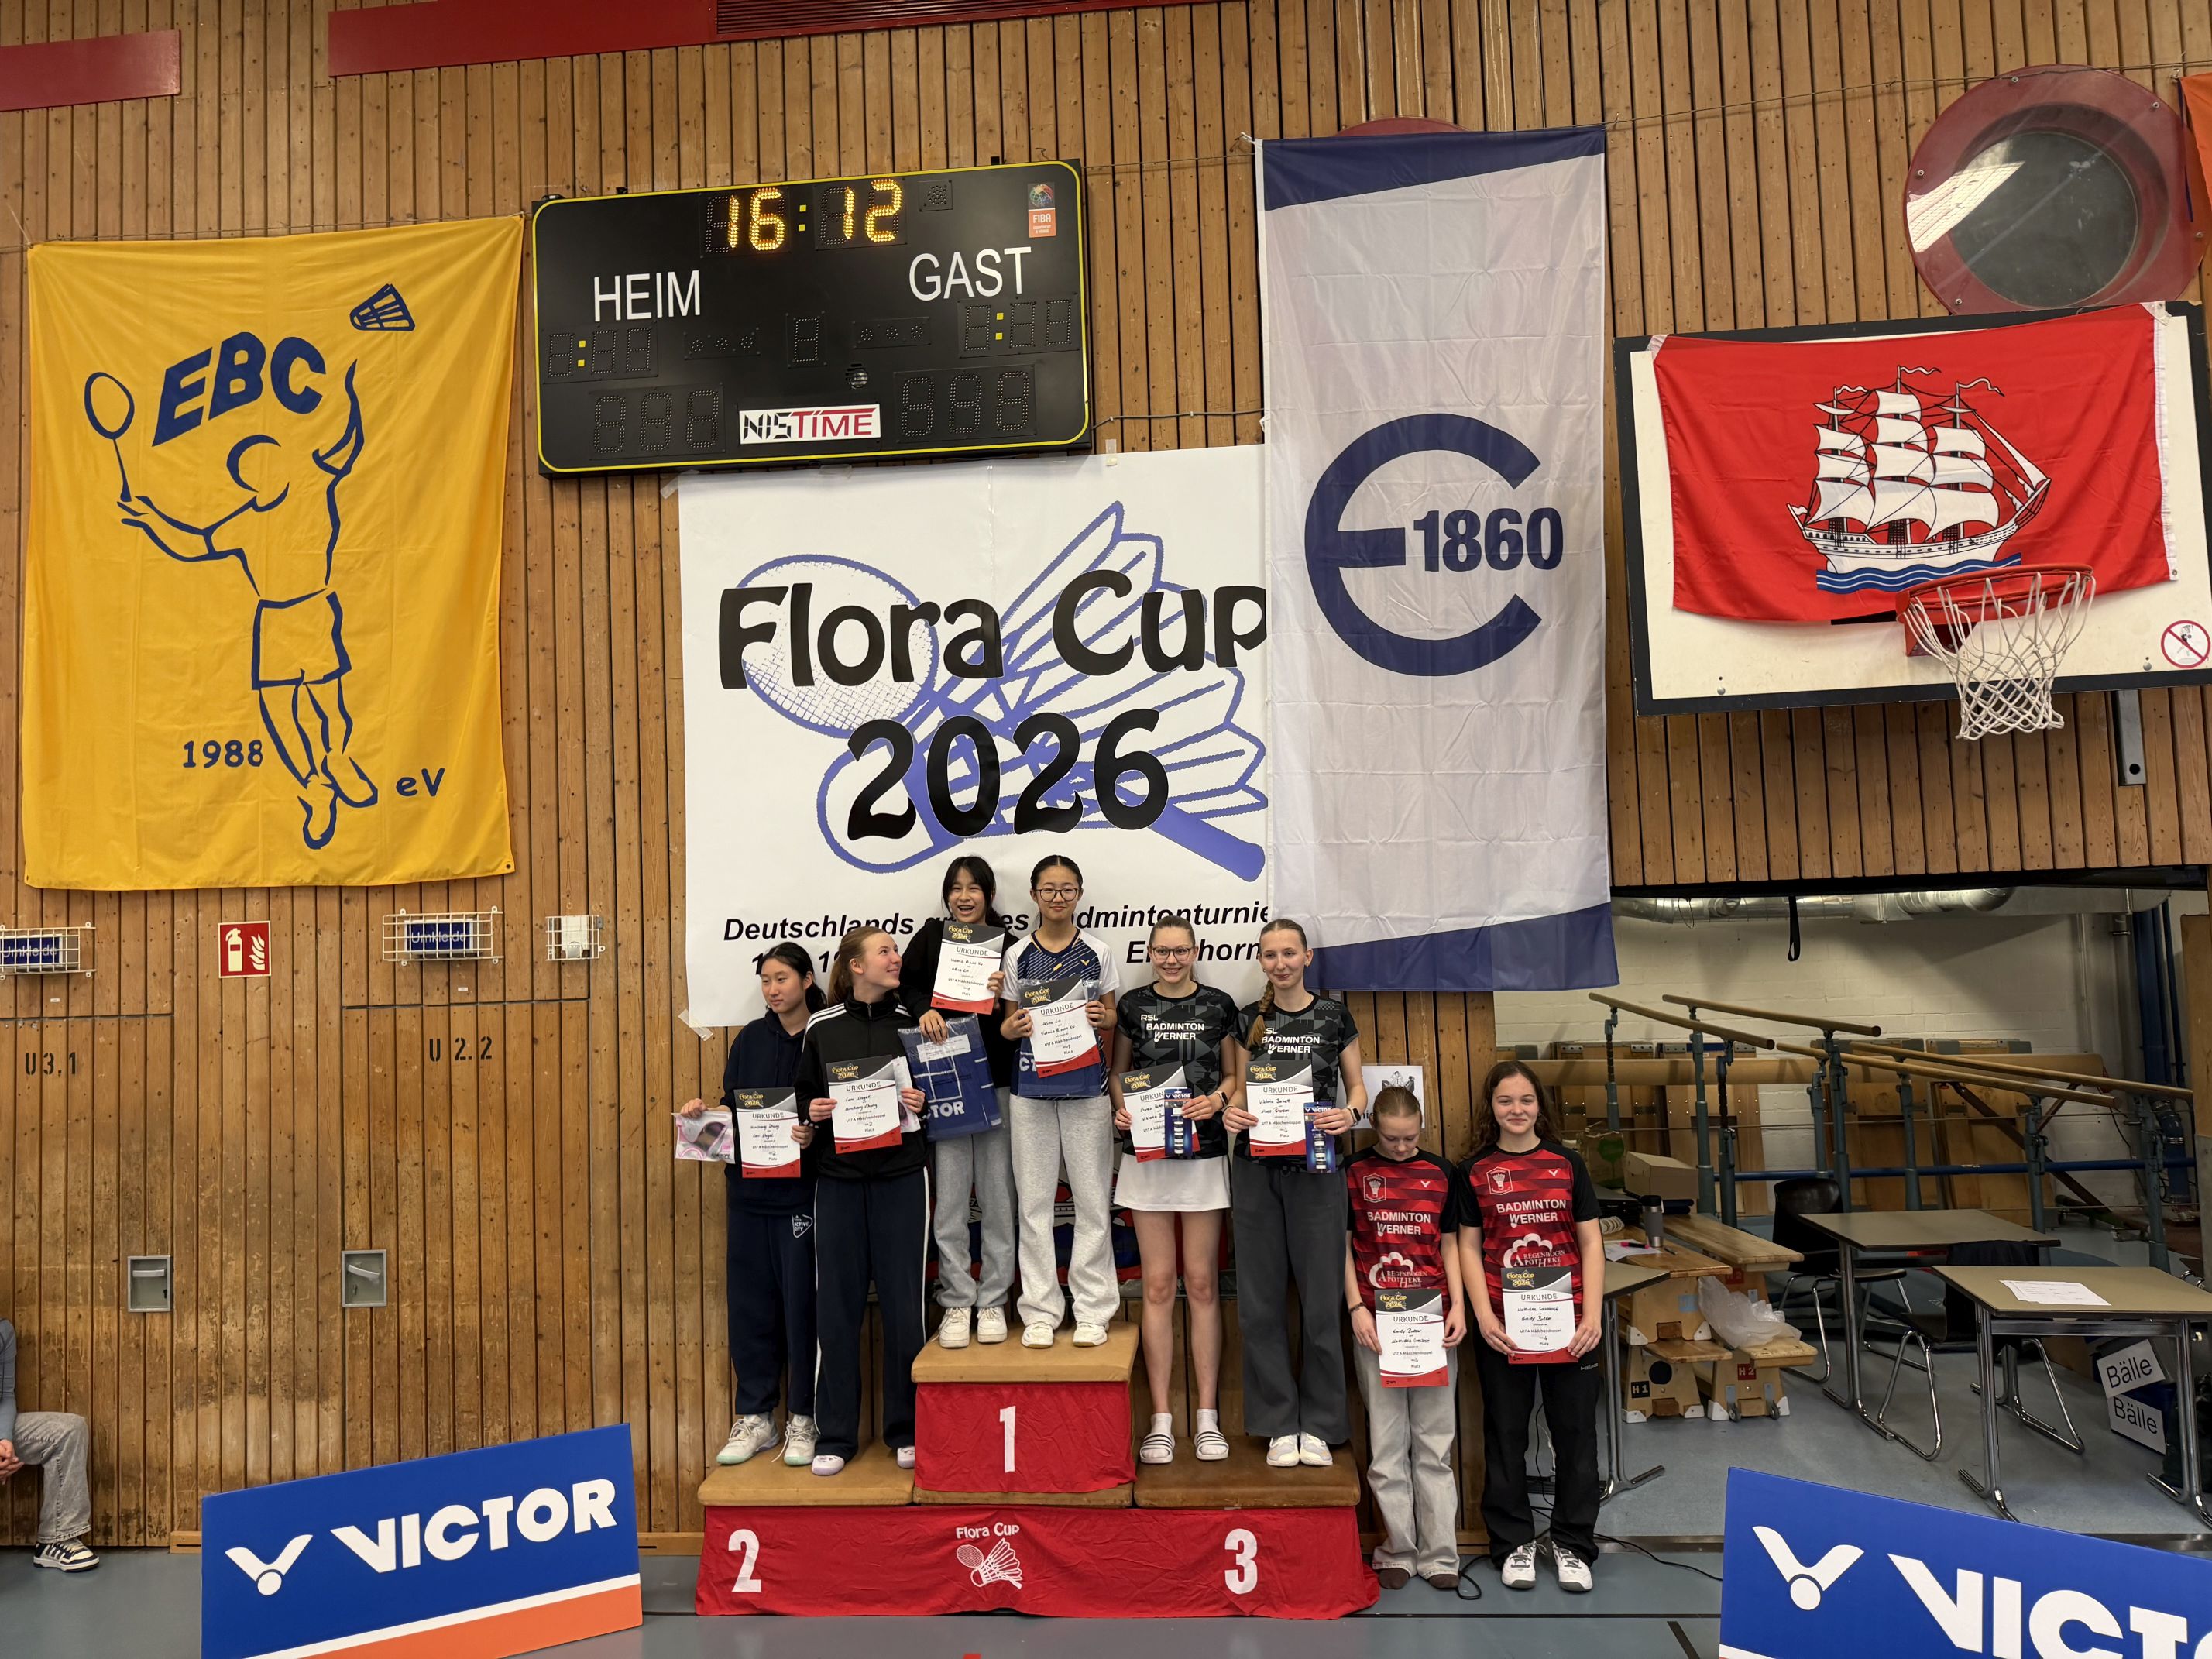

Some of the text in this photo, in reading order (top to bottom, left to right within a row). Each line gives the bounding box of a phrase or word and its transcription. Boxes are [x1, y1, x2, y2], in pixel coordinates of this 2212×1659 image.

[726, 178, 902, 251] 16:12
[1032, 213, 1052, 224] FIBA
[909, 246, 1032, 301] GAST
[593, 270, 700, 321] HEIM
[153, 331, 326, 446] EBC
[1413, 507, 1563, 572] 1860
[719, 569, 1267, 689] Flora Cup
[183, 740, 263, 768] 1988
[396, 768, 445, 797] eV
[847, 709, 1170, 840] 2026
[723, 913, 914, 941] Deutschlands
[956, 946, 989, 957] URKUNDE
[1040, 1002, 1074, 1015] URKUNDE
[1146, 1022, 1204, 1031] BADMINTON
[1154, 1031, 1196, 1042] WERNER
[1262, 1036, 1320, 1044] BADMINTON
[1268, 1043, 1310, 1054] WERNER
[846, 1081, 881, 1091] URKUNDE
[1140, 1091, 1165, 1101] URKUN
[1367, 1211, 1431, 1223] BADMINTON
[1496, 1199, 1567, 1213] BADMINTON
[1509, 1212, 1558, 1228] WERNER
[1377, 1222, 1421, 1237] WERNER
[2107, 1357, 2152, 1389] Bälle
[2113, 1396, 2158, 1434] Bälle
[998, 1406, 1017, 1473] 1
[330, 1479, 618, 1574] VICTOR
[956, 1523, 1020, 1539] Flora Cup
[727, 1529, 762, 1594] 2
[1224, 1528, 1259, 1595] 3
[1887, 1552, 2212, 1659] VICT
